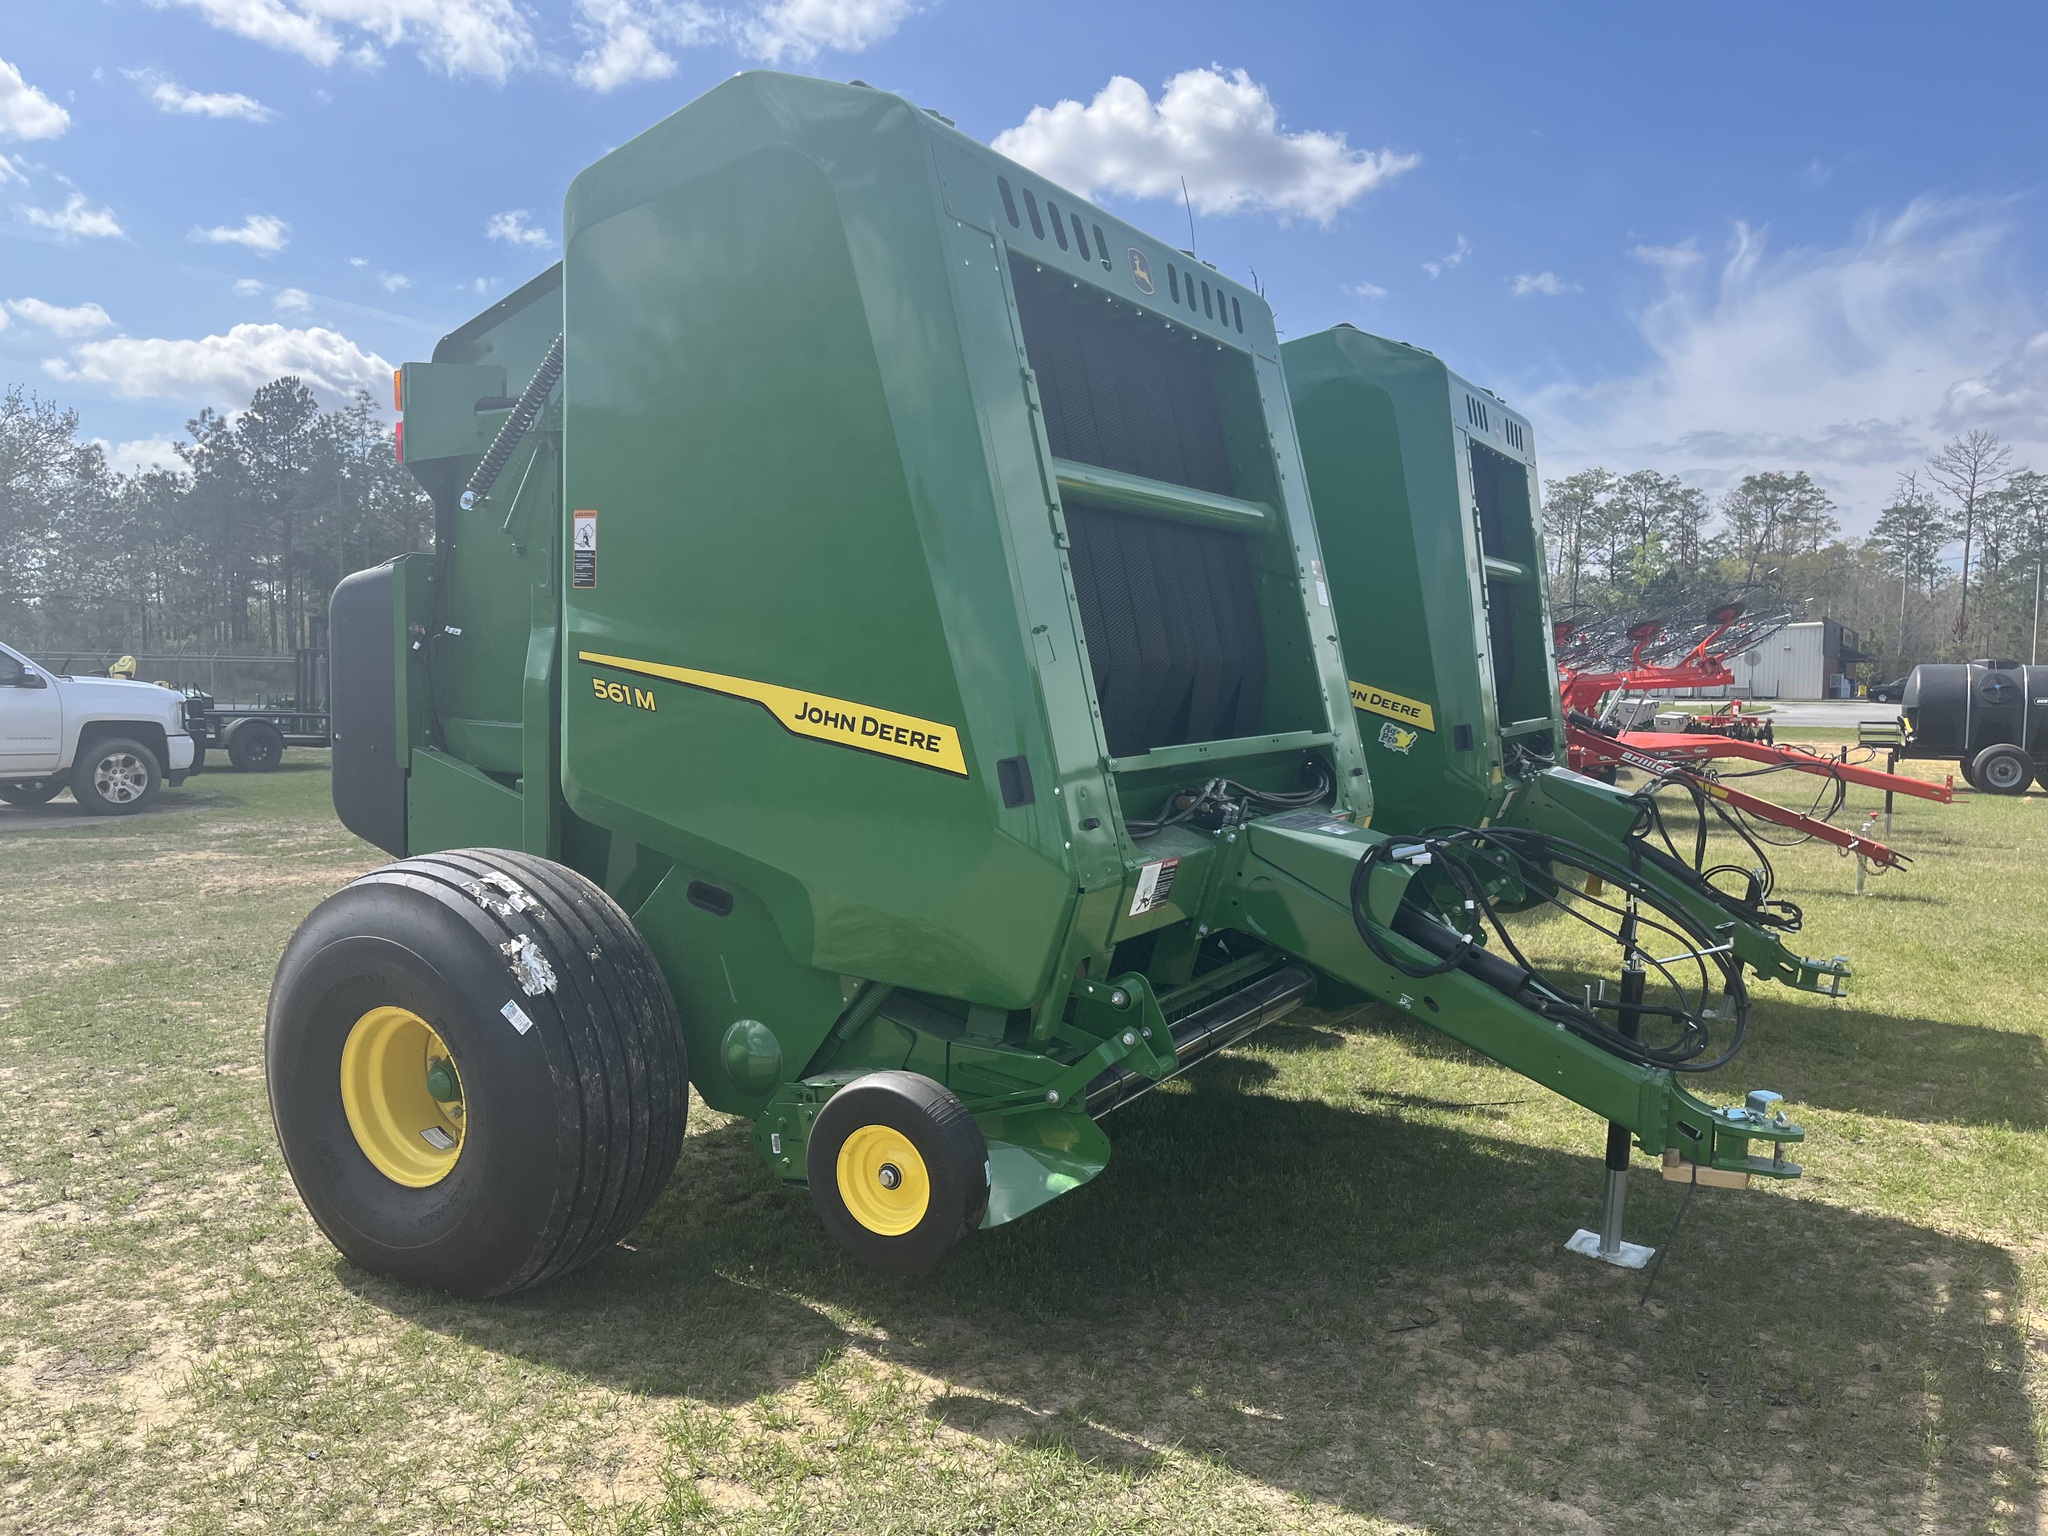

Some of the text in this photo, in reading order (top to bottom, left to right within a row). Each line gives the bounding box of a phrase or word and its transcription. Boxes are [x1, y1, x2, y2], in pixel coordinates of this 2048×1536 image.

[1370, 693, 1421, 718] DEERE
[795, 702, 941, 753] JOHN DEERE
